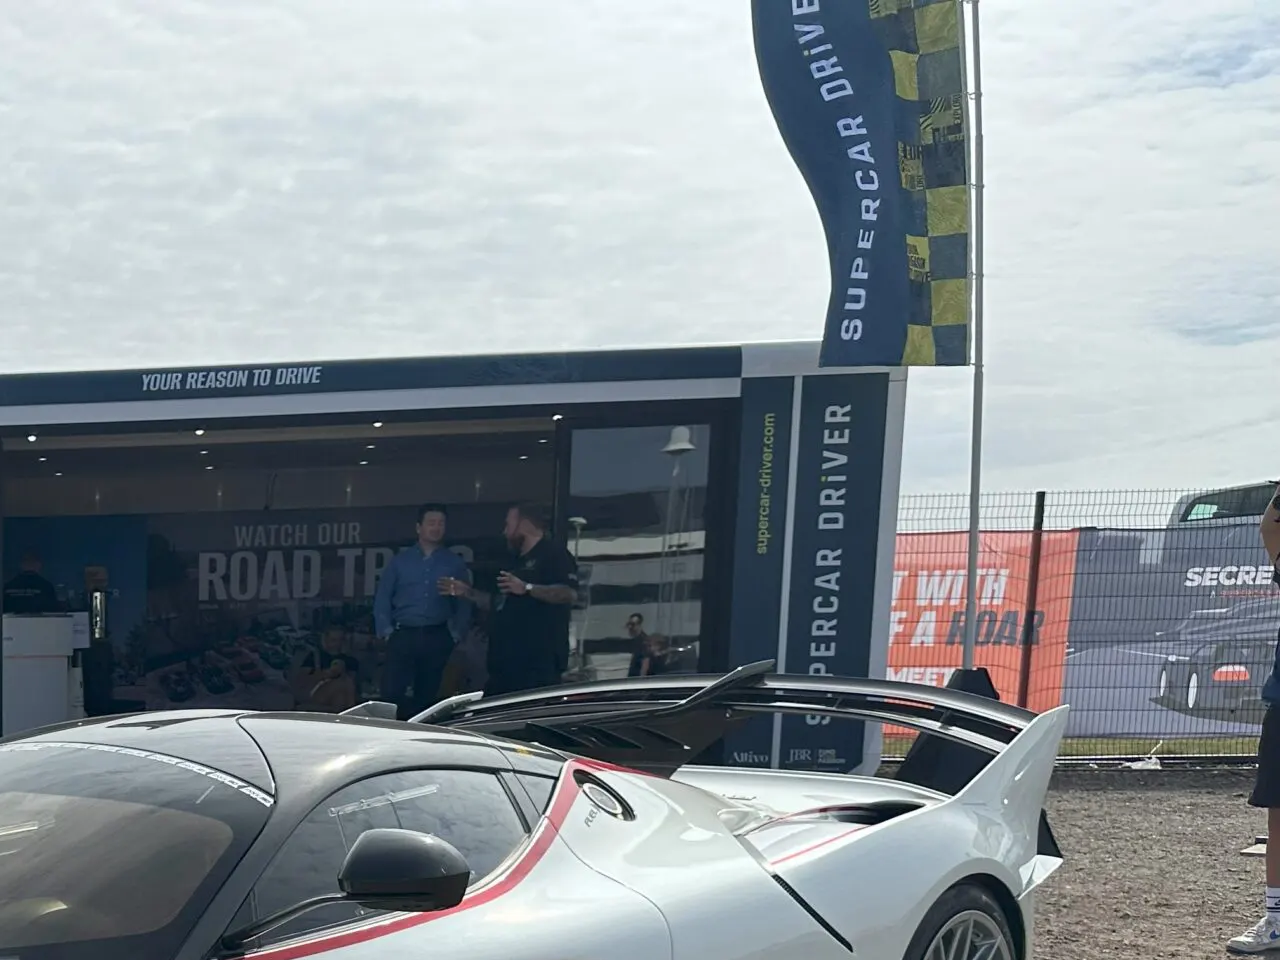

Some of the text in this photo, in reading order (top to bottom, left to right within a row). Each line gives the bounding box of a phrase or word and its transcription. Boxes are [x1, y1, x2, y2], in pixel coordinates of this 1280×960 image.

[837, 113, 881, 341] SUPERCAR
[142, 366, 322, 391] YOUR REASON TO DRIVE
[757, 413, 776, 554] supercar-driver.com
[818, 404, 851, 529] DRiVER
[234, 522, 361, 547] WATCH OUR
[199, 550, 320, 600] ROAD
[805, 549, 842, 725] SPERCAR
[910, 611, 937, 647] A
[945, 610, 1045, 646] ROAR
[785, 749, 812, 764] JBR
